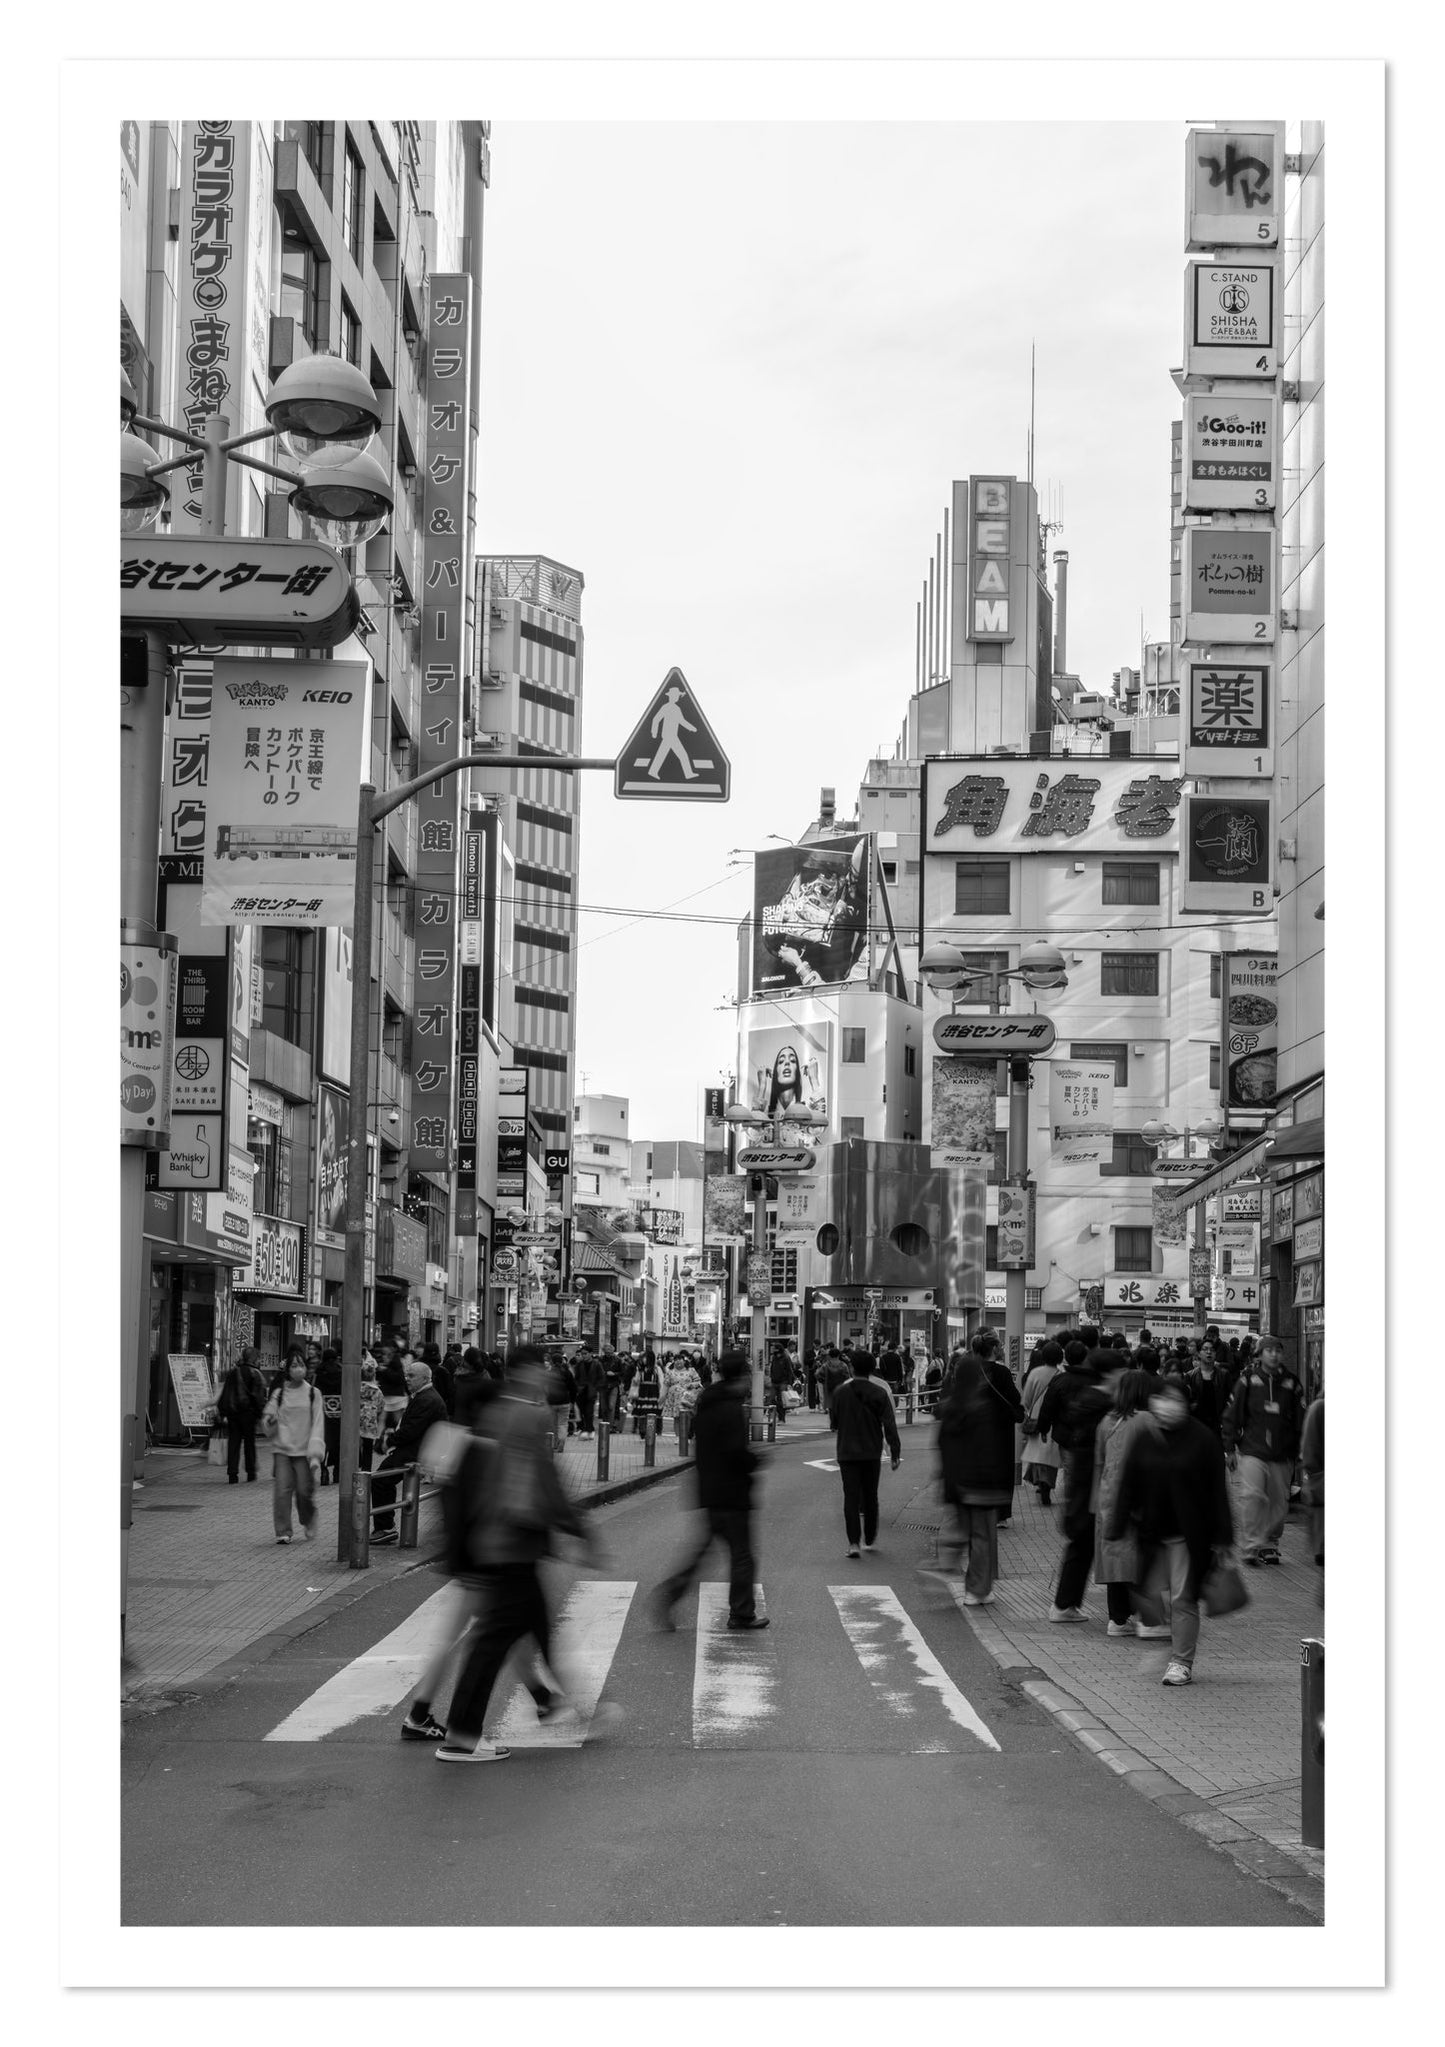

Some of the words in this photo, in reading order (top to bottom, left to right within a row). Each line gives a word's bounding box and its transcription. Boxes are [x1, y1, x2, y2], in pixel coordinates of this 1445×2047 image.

[192, 134, 235, 280] カラオケ
[1257, 222, 1270, 239] 5
[1210, 272, 1258, 283] C.STAND
[1210, 315, 1258, 327] SHISHA
[1210, 327, 1257, 336] CAFE&BAR
[1255, 355, 1269, 371] 4
[1196, 464, 1268, 477] 全身もみほぐし
[1254, 488, 1268, 505] 3
[976, 480, 1009, 634] BEAM
[120, 558, 334, 597] 谷センター街
[1254, 621, 1267, 639] 2
[239, 698, 276, 707] KANTO
[302, 690, 353, 704] KEIO
[1200, 672, 1254, 726] 薬
[1194, 729, 1260, 744] マツモトキヨシ
[243, 727, 261, 772] 冒険へ
[262, 727, 282, 805] カントーの
[306, 728, 326, 791] 京王線で
[1253, 756, 1262, 772] 1
[935, 775, 1182, 838] 角海老
[467, 835, 477, 874] kimono
[229, 896, 324, 912] 渋谷センター街
[1252, 891, 1265, 907] B
[188, 968, 203, 976] THE
[1231, 973, 1277, 986] 四川料理
[183, 976, 206, 985] THIRD
[183, 1006, 205, 1014] ROOM
[186, 1017, 201, 1025] BAR
[940, 1023, 1048, 1039] 渋谷センター街
[1229, 1033, 1259, 1054] 6F
[952, 1078, 980, 1086] KANTO
[170, 1152, 206, 1164] Whisky
[547, 1156, 568, 1168] GU
[169, 1162, 191, 1171] Bank
